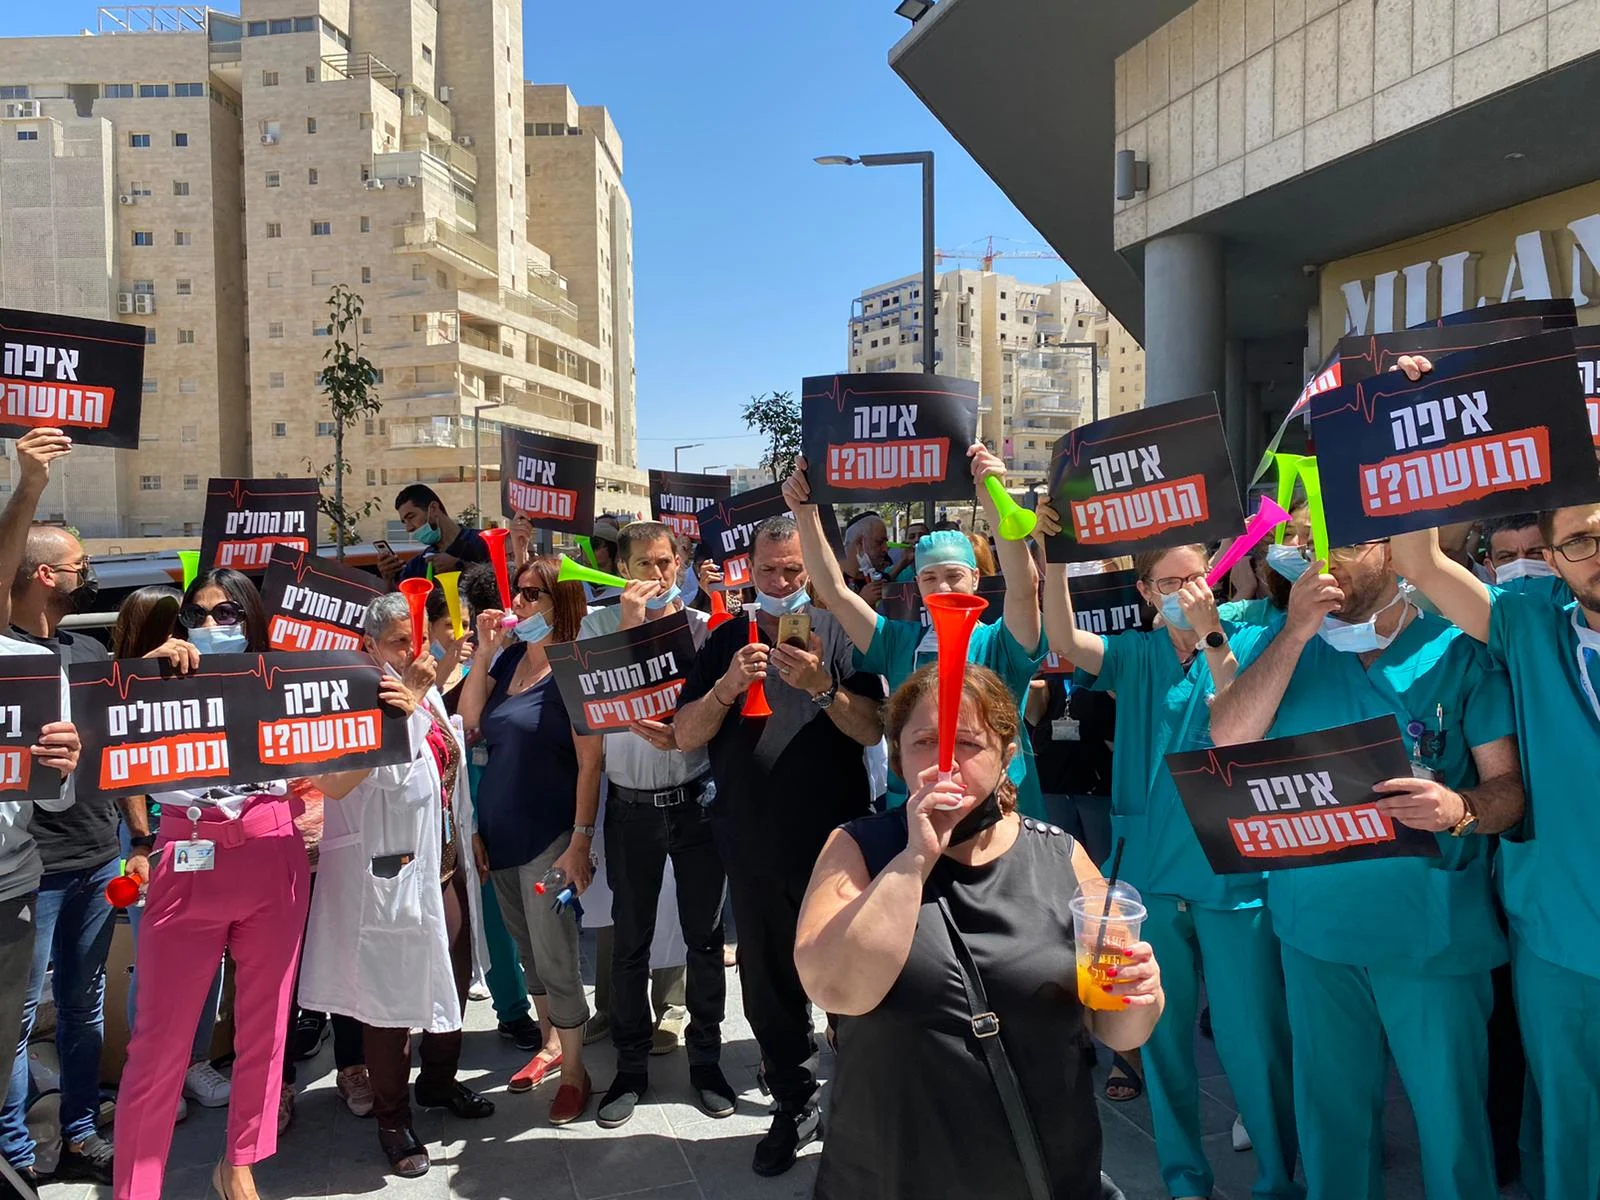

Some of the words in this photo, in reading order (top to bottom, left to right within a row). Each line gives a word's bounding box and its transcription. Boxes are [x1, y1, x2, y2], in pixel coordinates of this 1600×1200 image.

[4, 342, 79, 381] איפה
[0, 382, 104, 424] הבושה
[1390, 390, 1493, 451] איפה
[854, 404, 918, 439] איפה
[517, 455, 556, 486] איפה
[831, 444, 941, 480] הבושה?!
[1090, 445, 1165, 492] איפה
[1364, 436, 1542, 509] הבושה?!
[509, 481, 571, 517] הבושה?!
[660, 493, 694, 513] החולים
[1075, 483, 1202, 538] הבושה?!
[225, 509, 281, 535] החולים
[282, 510, 305, 533] בית
[221, 544, 258, 565] חיים
[281, 584, 342, 622] החולים
[1110, 603, 1142, 630] בית
[272, 618, 312, 649] חיים
[578, 662, 646, 696] החולים
[646, 651, 679, 682] בית
[284, 680, 350, 715] איפה
[588, 701, 631, 724] חיים
[108, 700, 202, 737] החולים
[262, 716, 376, 758] הבושה?!
[110, 745, 169, 781] חיים
[1246, 771, 1340, 812] איפה
[1234, 808, 1388, 852] הבושה?!
